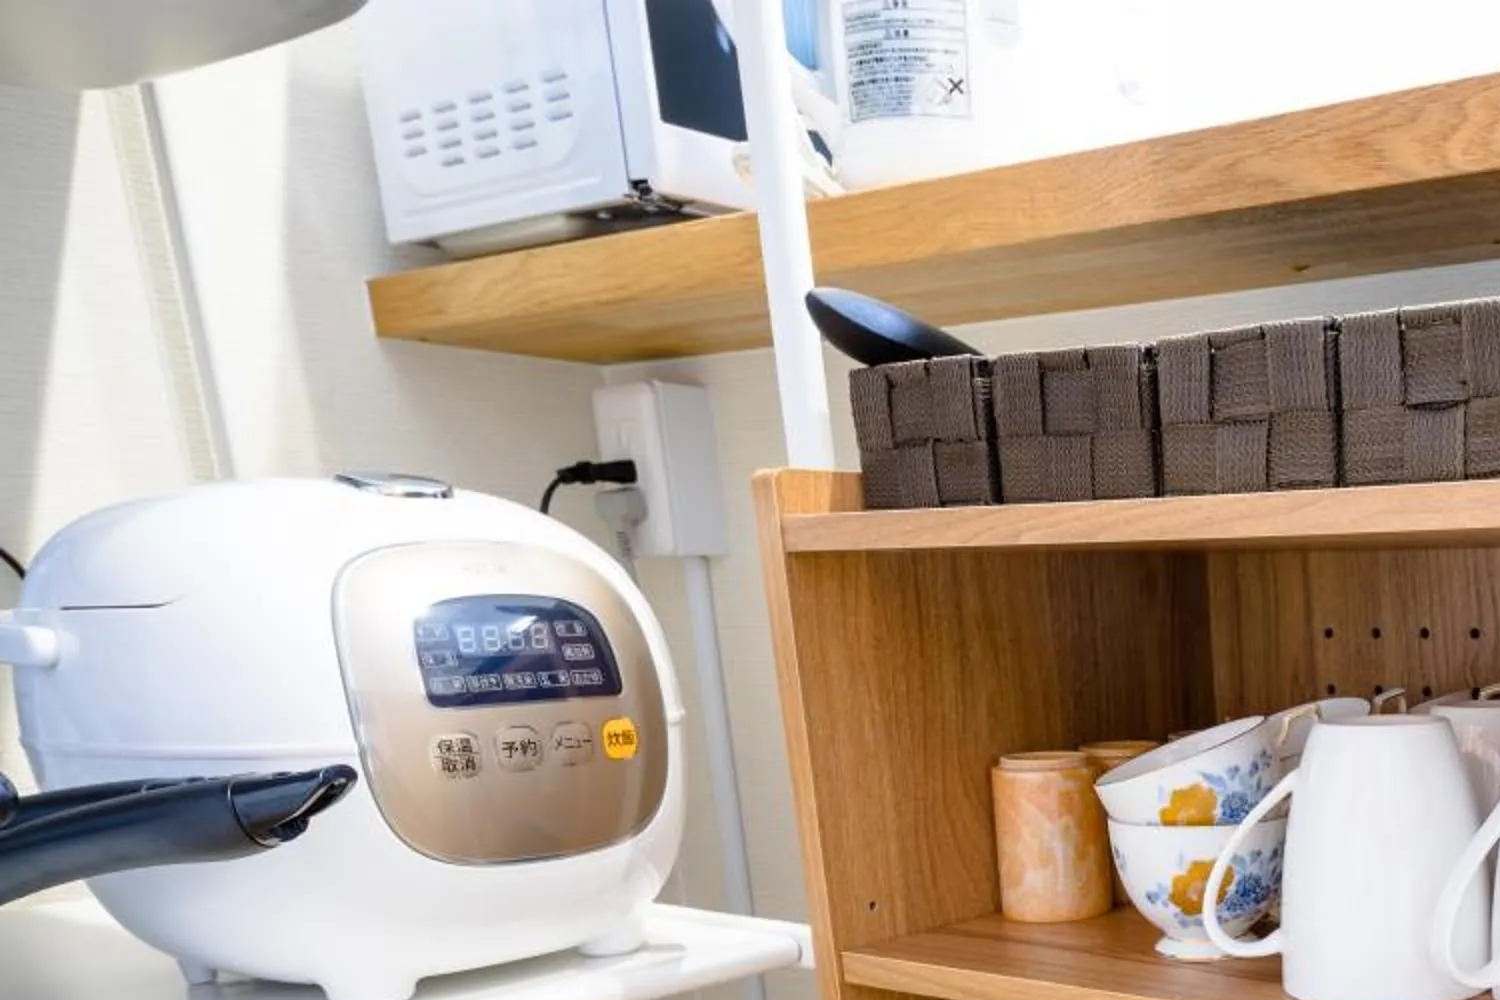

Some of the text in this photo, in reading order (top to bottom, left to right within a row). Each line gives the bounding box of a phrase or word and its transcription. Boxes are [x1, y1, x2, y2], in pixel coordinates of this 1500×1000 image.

[437, 736, 473, 755] 保温
[501, 739, 537, 758] 予約
[555, 735, 593, 750] メニュー
